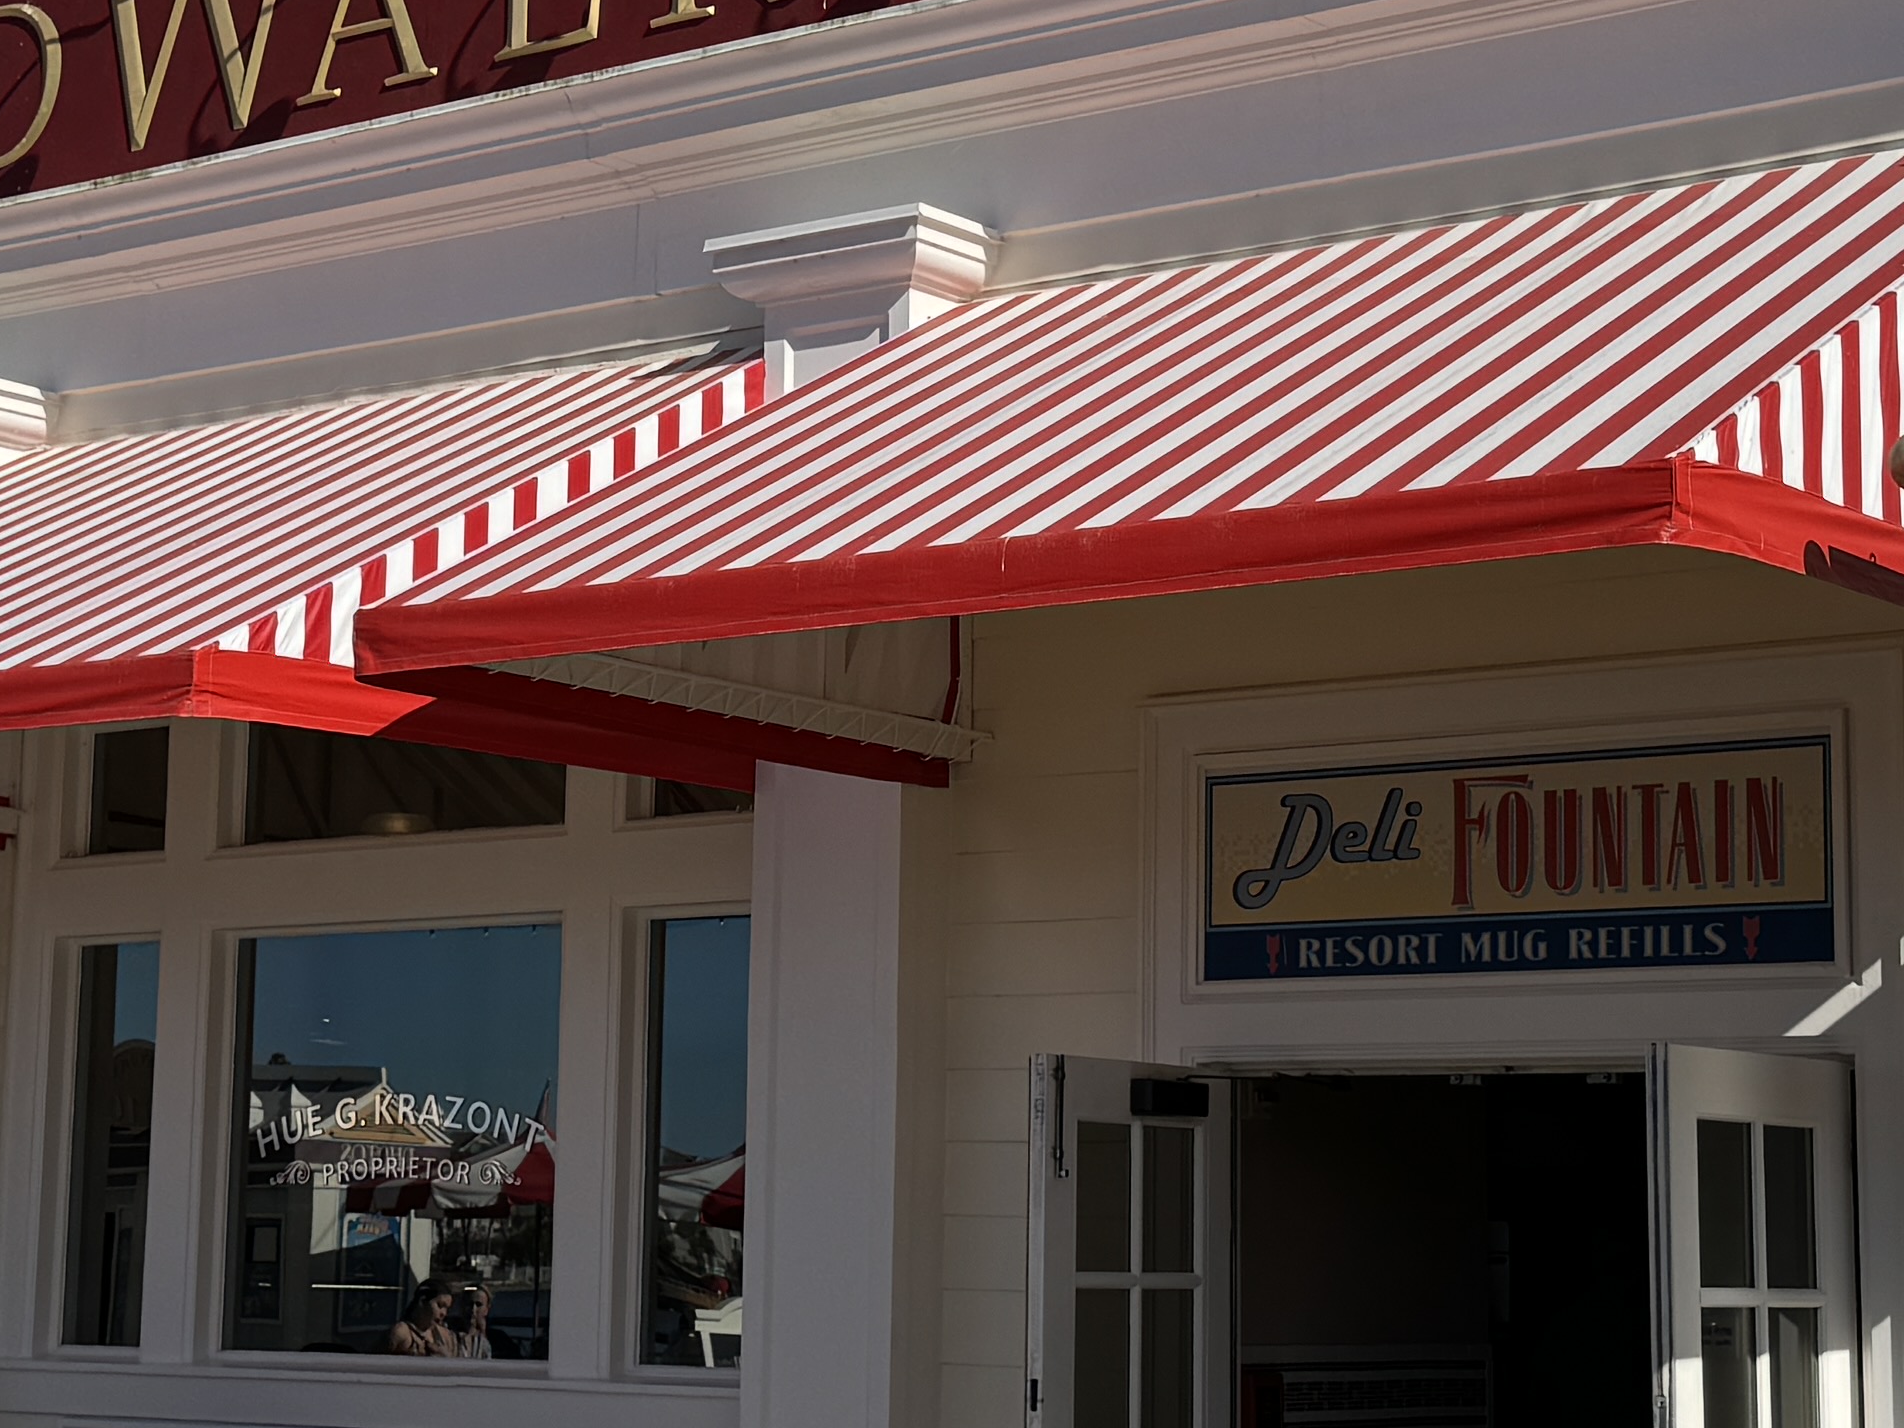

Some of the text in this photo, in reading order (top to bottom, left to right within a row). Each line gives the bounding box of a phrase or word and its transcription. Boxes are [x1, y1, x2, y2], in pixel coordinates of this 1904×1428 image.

[1232, 774, 1785, 912] Deli FOUNTAIN
[1298, 922, 1728, 970] RESORT MUG REFILLS
[256, 1093, 545, 1158] HUE G. KRAZONT
[323, 1158, 471, 1186] PROPRIETOR
